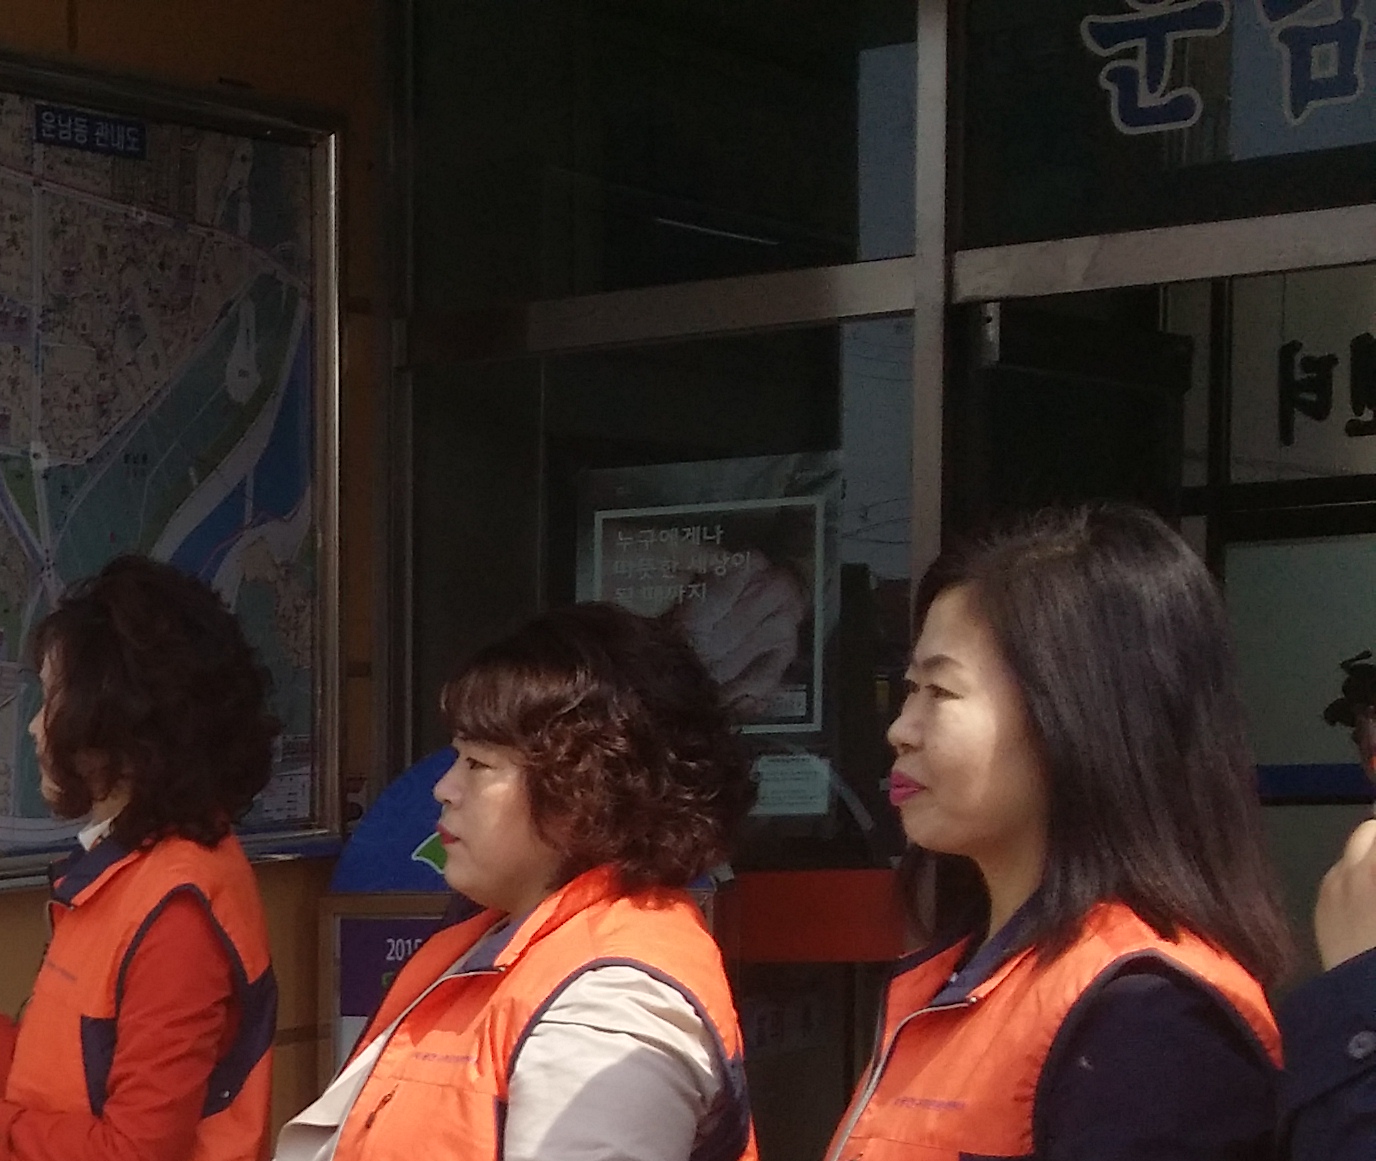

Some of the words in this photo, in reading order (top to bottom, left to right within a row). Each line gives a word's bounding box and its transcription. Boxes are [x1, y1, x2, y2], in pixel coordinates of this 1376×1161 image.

[42, 111, 88, 144] 운남동
[95, 121, 141, 151] 관내도
[616, 524, 725, 551] 누구에게나
